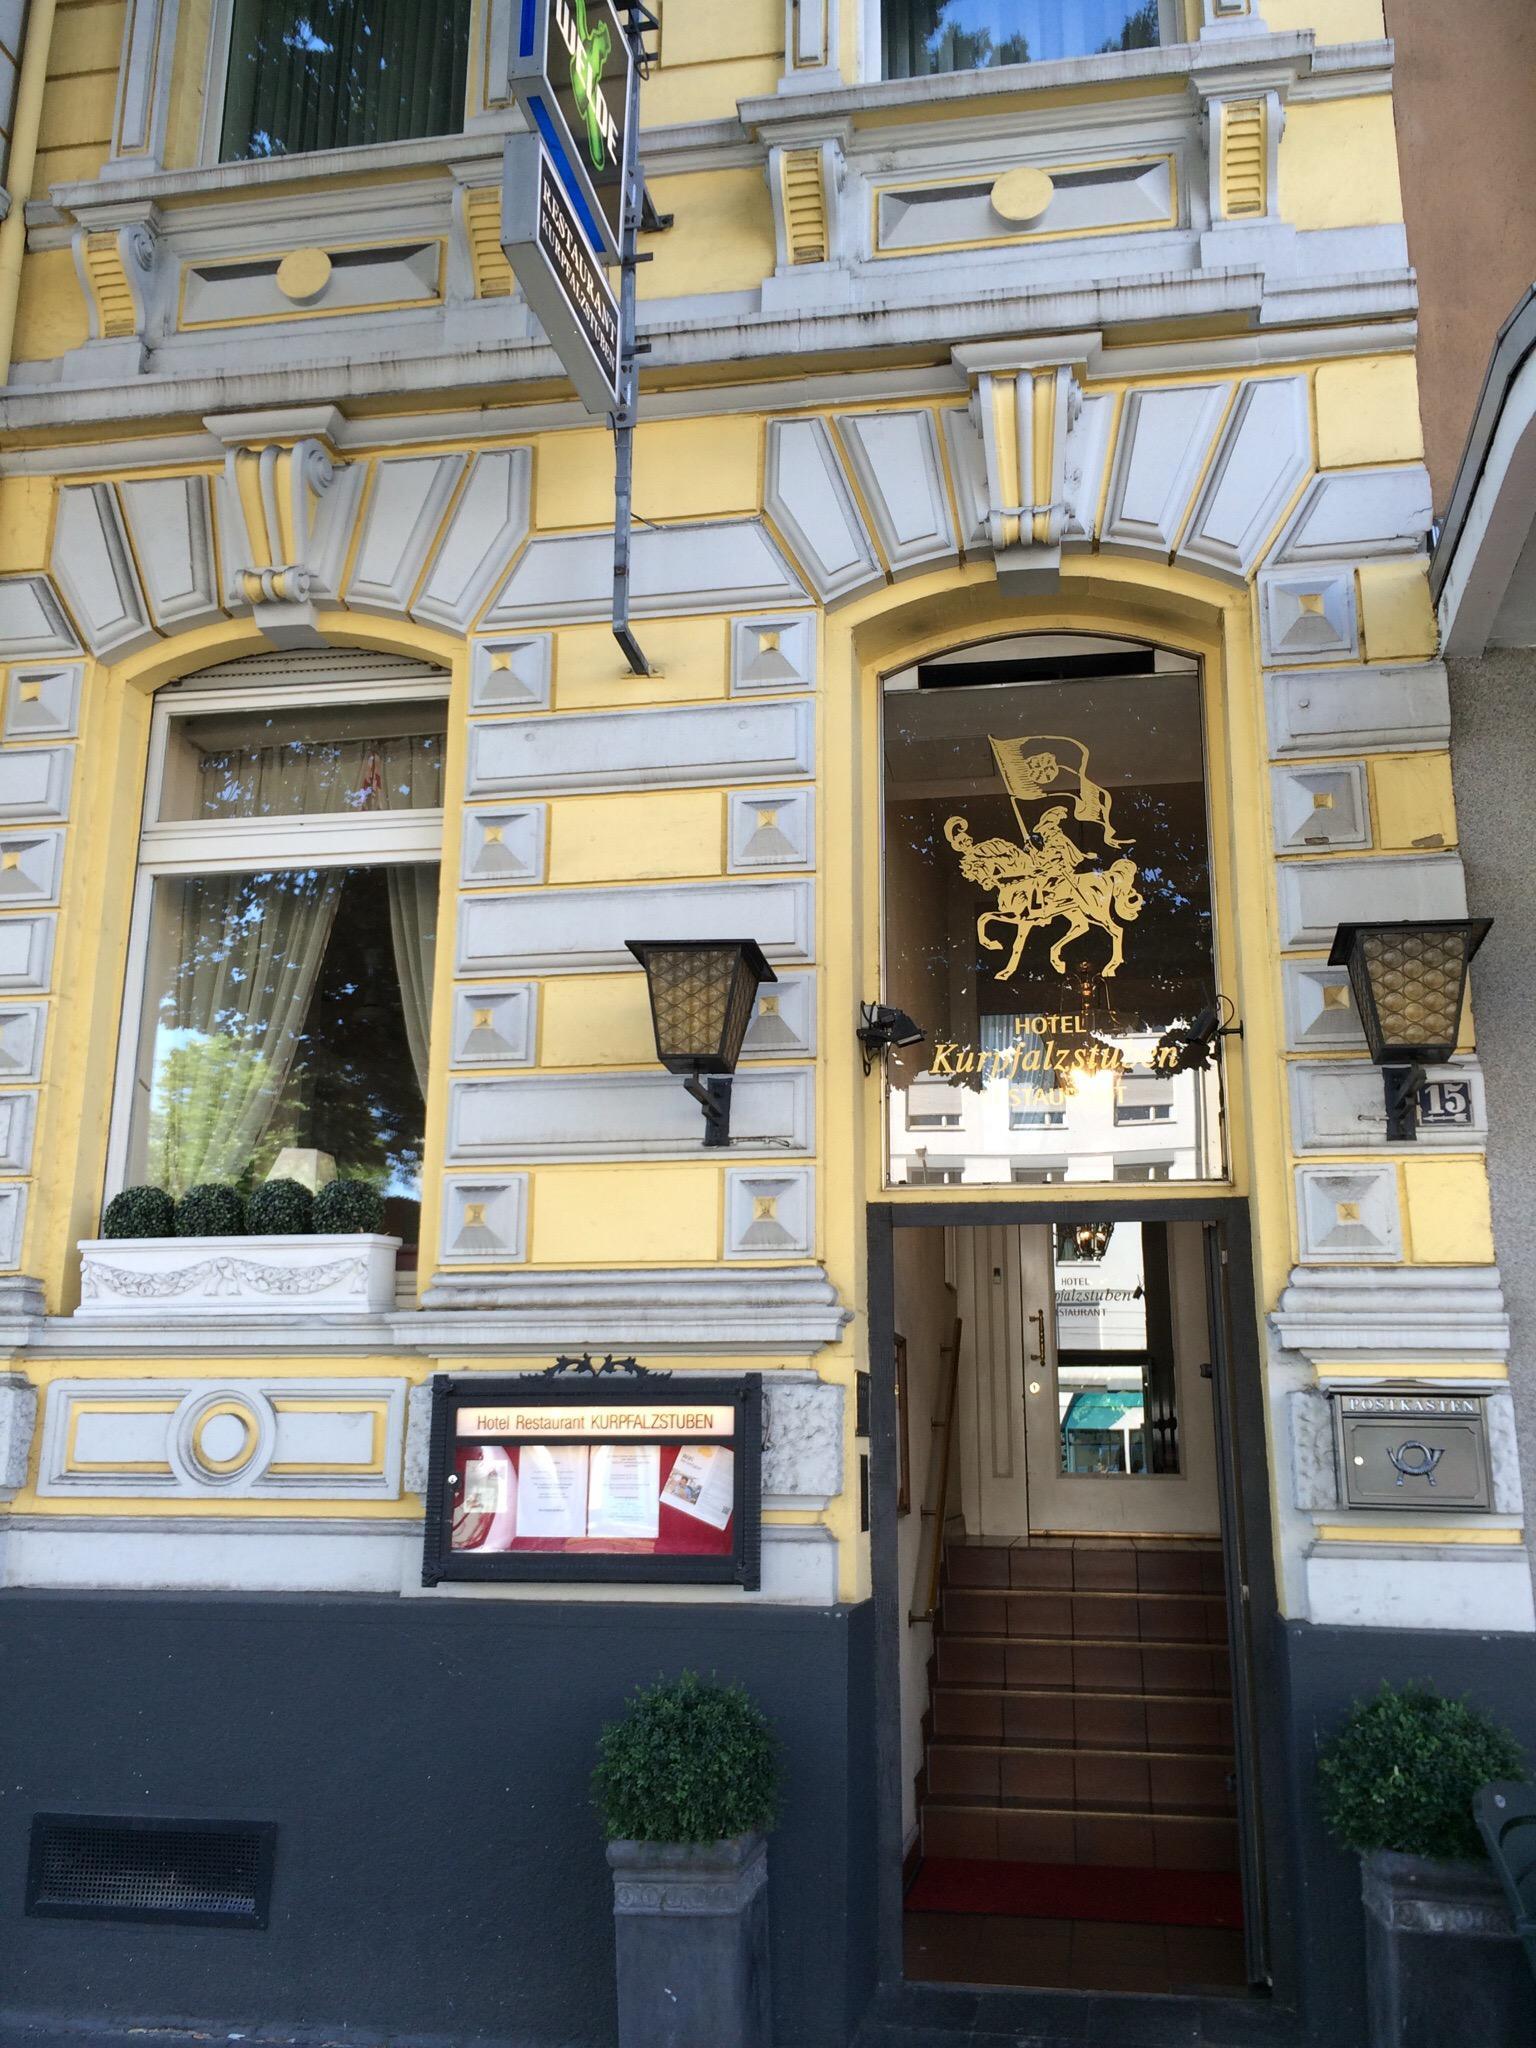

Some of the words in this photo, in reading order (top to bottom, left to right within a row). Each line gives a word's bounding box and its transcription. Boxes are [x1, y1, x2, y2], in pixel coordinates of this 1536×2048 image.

[556, 0, 618, 166] WELDE
[543, 177, 616, 345] RESTAURANT
[541, 210, 616, 373] KURPFALZSTUBEN
[1015, 1015, 1087, 1035] HOTEL
[928, 1040, 1179, 1079] Kurpfalzstuen
[1424, 1082, 1468, 1116] 15
[1061, 1277, 1089, 1286] HOTEL
[477, 1415, 509, 1430] Hotel
[516, 1415, 585, 1430] Restaurant
[591, 1413, 714, 1430] KURPFALZSTUBEN
[1349, 1398, 1474, 1412] POSTKASTEN
